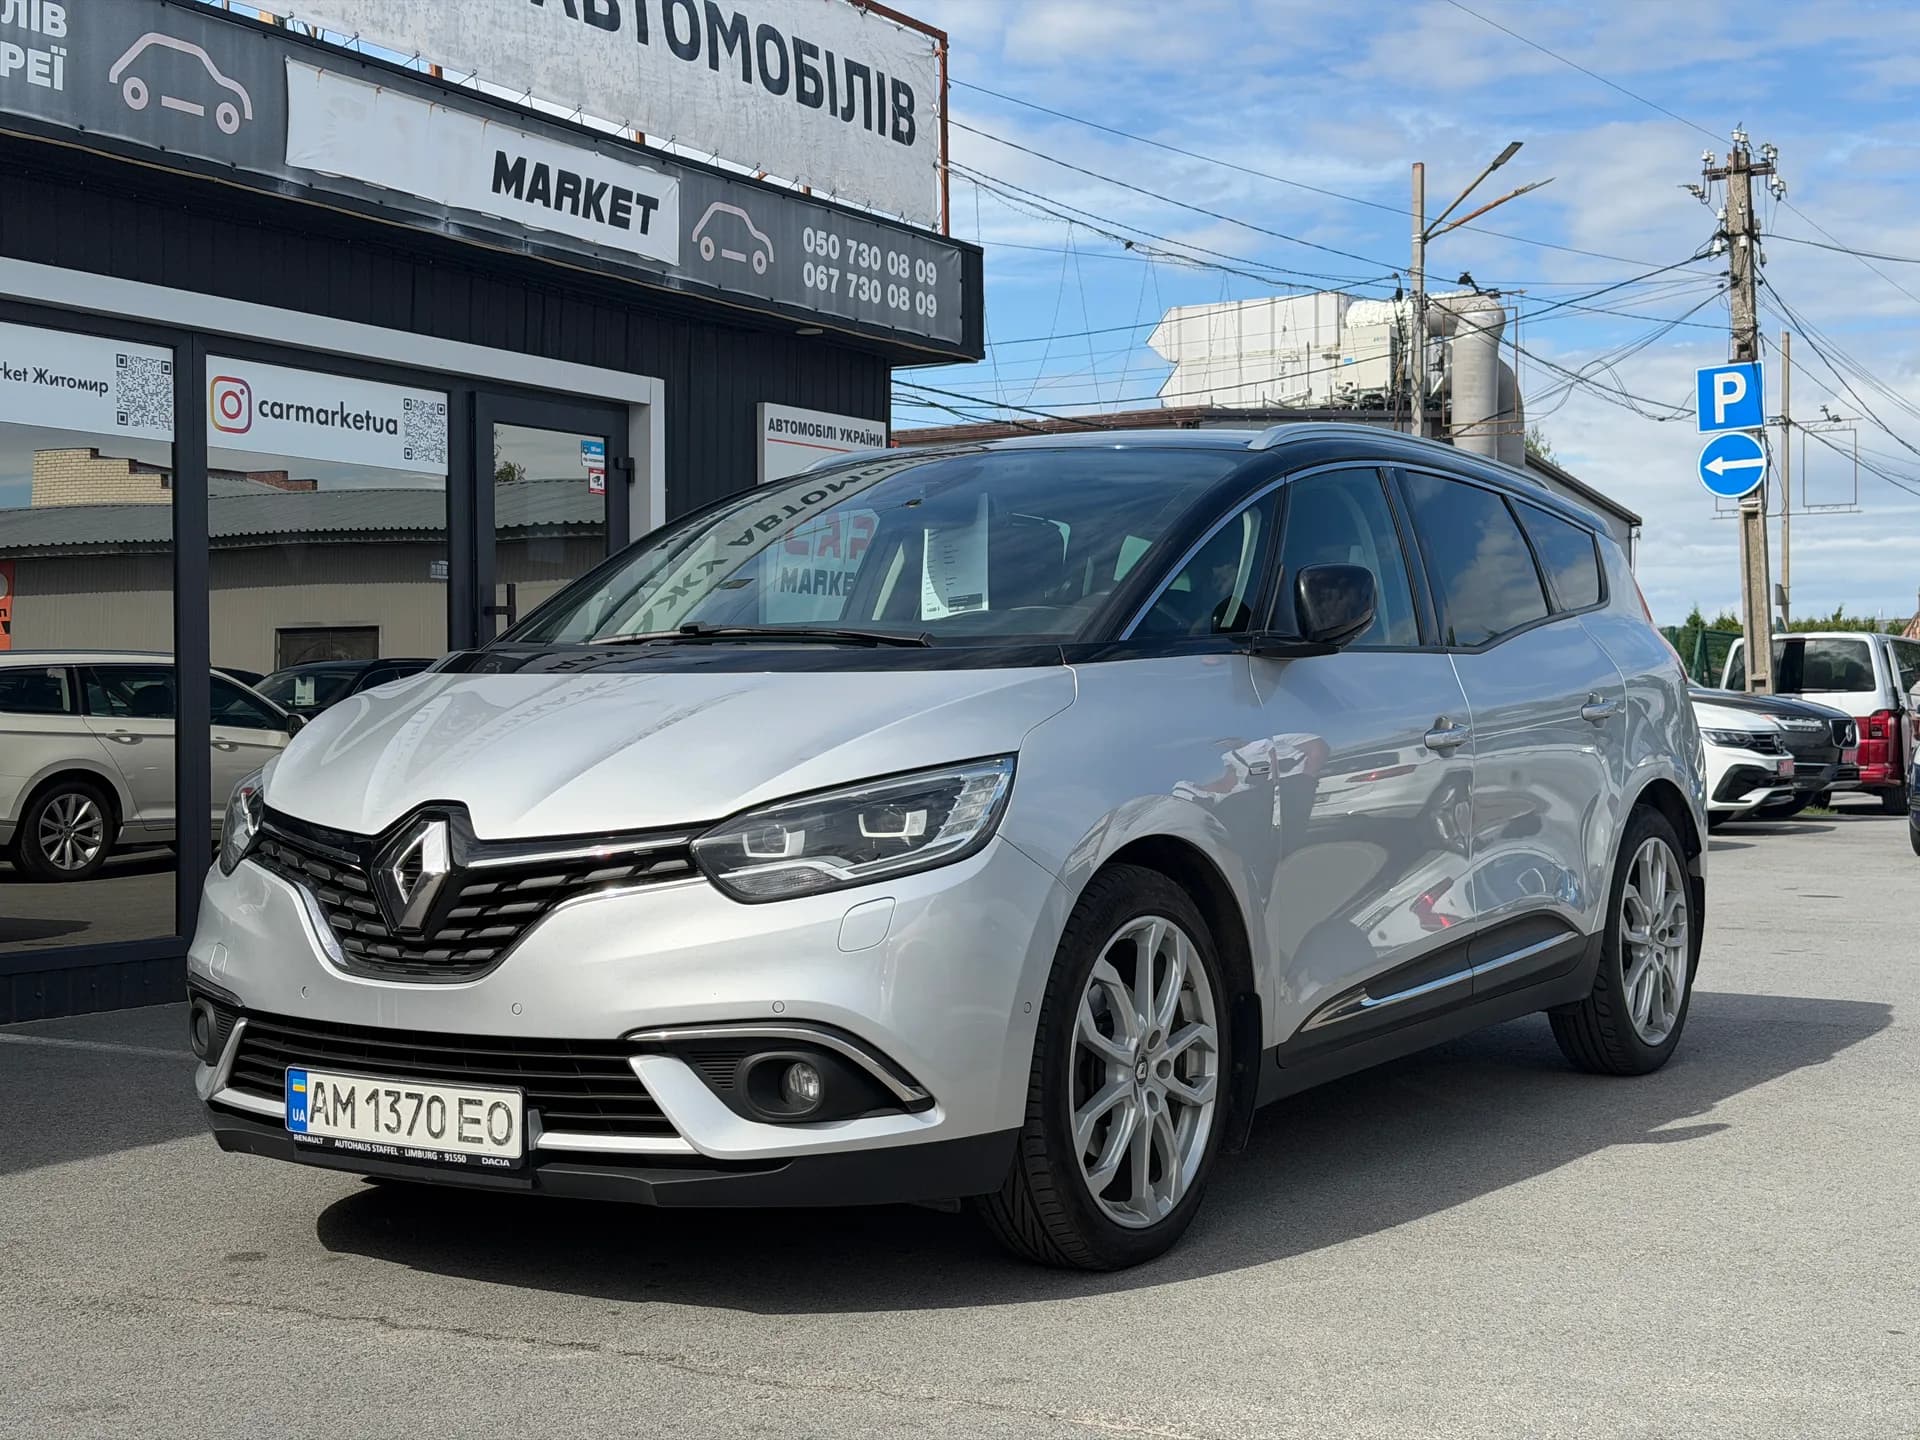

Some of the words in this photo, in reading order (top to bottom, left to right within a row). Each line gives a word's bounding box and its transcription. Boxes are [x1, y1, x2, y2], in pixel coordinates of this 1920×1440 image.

[492, 150, 659, 235] MARKET
[803, 227, 840, 260] 050
[846, 239, 881, 271] 730
[887, 251, 910, 279] 08
[915, 259, 937, 286] 09
[803, 262, 840, 294] 067
[846, 273, 881, 304] 730
[887, 284, 910, 311] 08
[915, 291, 937, 318] 09
[32, 367, 109, 397] Житомир
[1714, 372, 1747, 424] P
[258, 400, 399, 436] carmarketua
[768, 417, 837, 441] АВТОМОБІЛІ
[839, 428, 884, 448] УКРАЇНИ
[292, 1107, 306, 1123] UA
[309, 1081, 356, 1130] AM
[365, 1088, 447, 1140] 1370
[457, 1097, 513, 1147] EO
[293, 1133, 324, 1145] RENAULT
[334, 1139, 371, 1152] AUTOHAUS
[371, 1143, 399, 1156] STAFFEL
[404, 1148, 438, 1160] LIMBURG
[444, 1153, 467, 1164] 91550
[481, 1157, 511, 1167] DACIA
